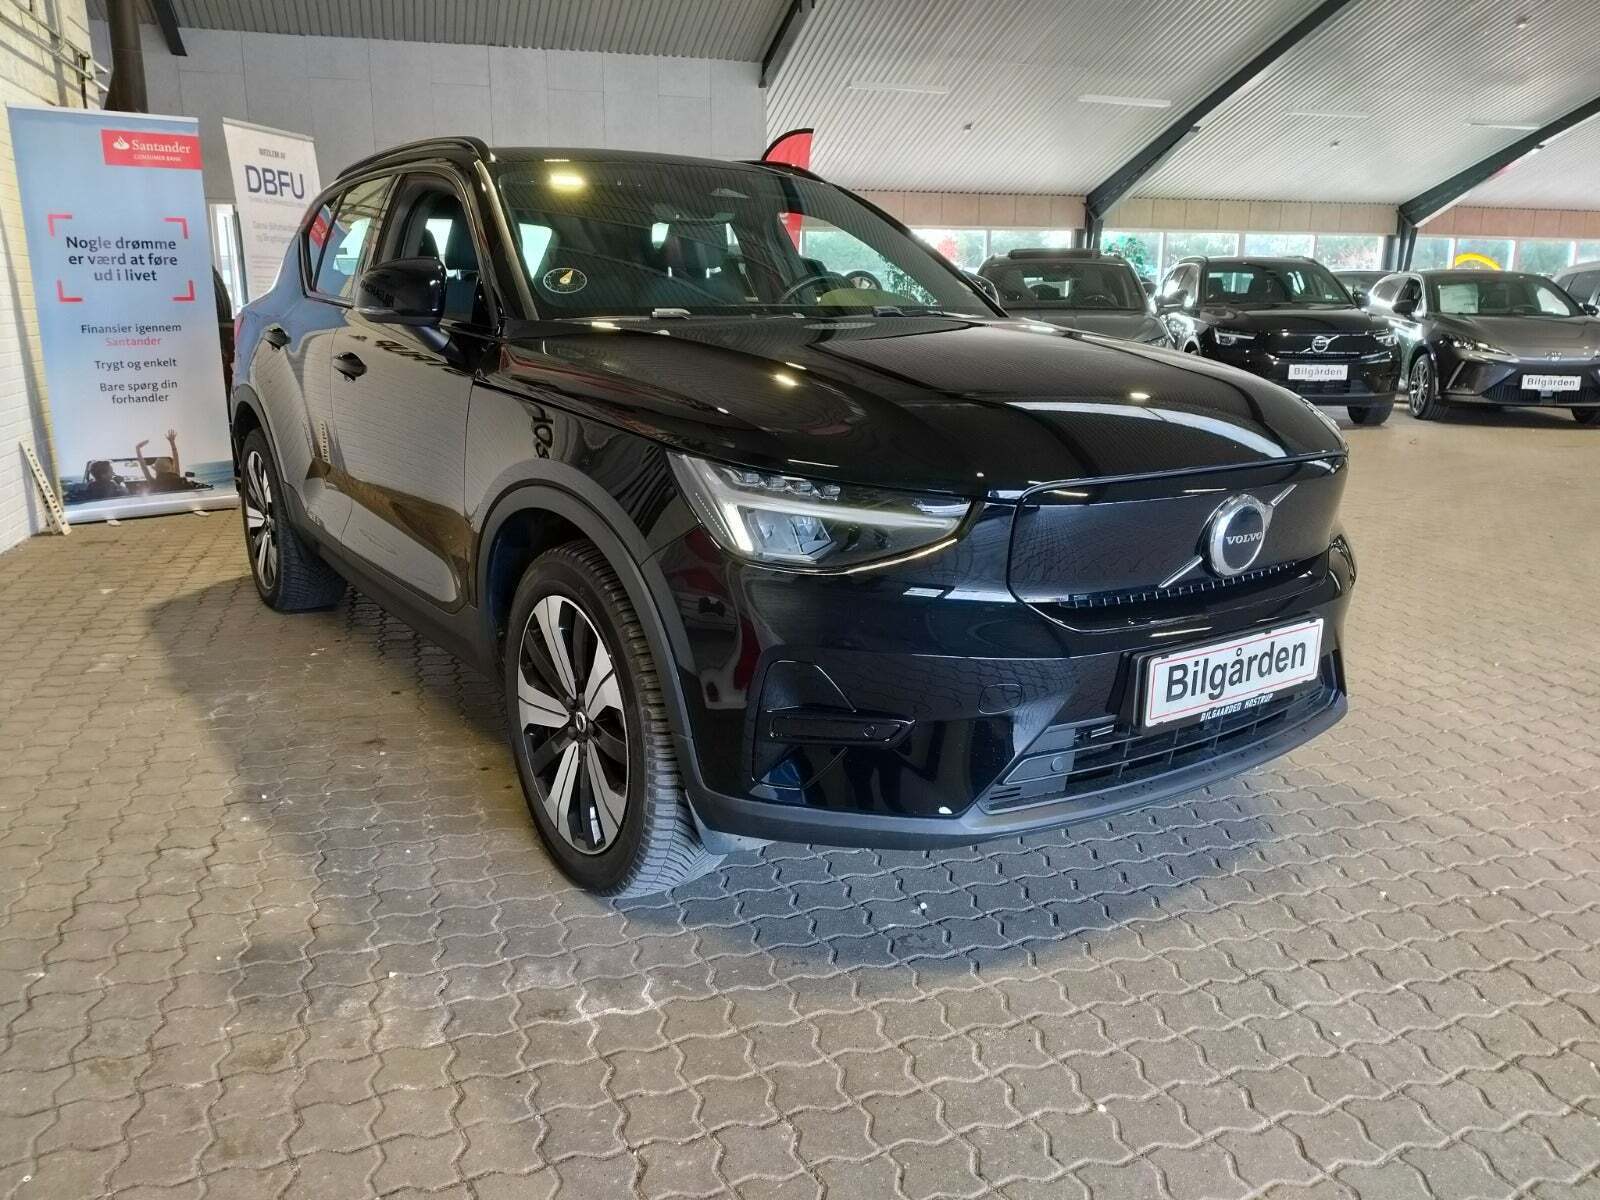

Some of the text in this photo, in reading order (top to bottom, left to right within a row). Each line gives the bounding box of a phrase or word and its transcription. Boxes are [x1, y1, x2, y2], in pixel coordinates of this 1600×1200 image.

[131, 139, 191, 154] Santander
[244, 165, 305, 200] DBFU
[65, 236, 177, 252] Nogle drømme
[68, 252, 178, 266] er værd at føre
[94, 268, 157, 281] ud i livet
[81, 323, 182, 335] Finansier igennem
[105, 336, 161, 347] Santander
[95, 357, 177, 371] Trygt og enkelt
[1294, 367, 1342, 378] Bilgården
[99, 379, 178, 392] Bare spørg din
[1527, 377, 1575, 387] Bilgården
[112, 392, 169, 404] forhandler
[1226, 531, 1263, 545] VOLVO
[1166, 640, 1307, 702] Bilgården
